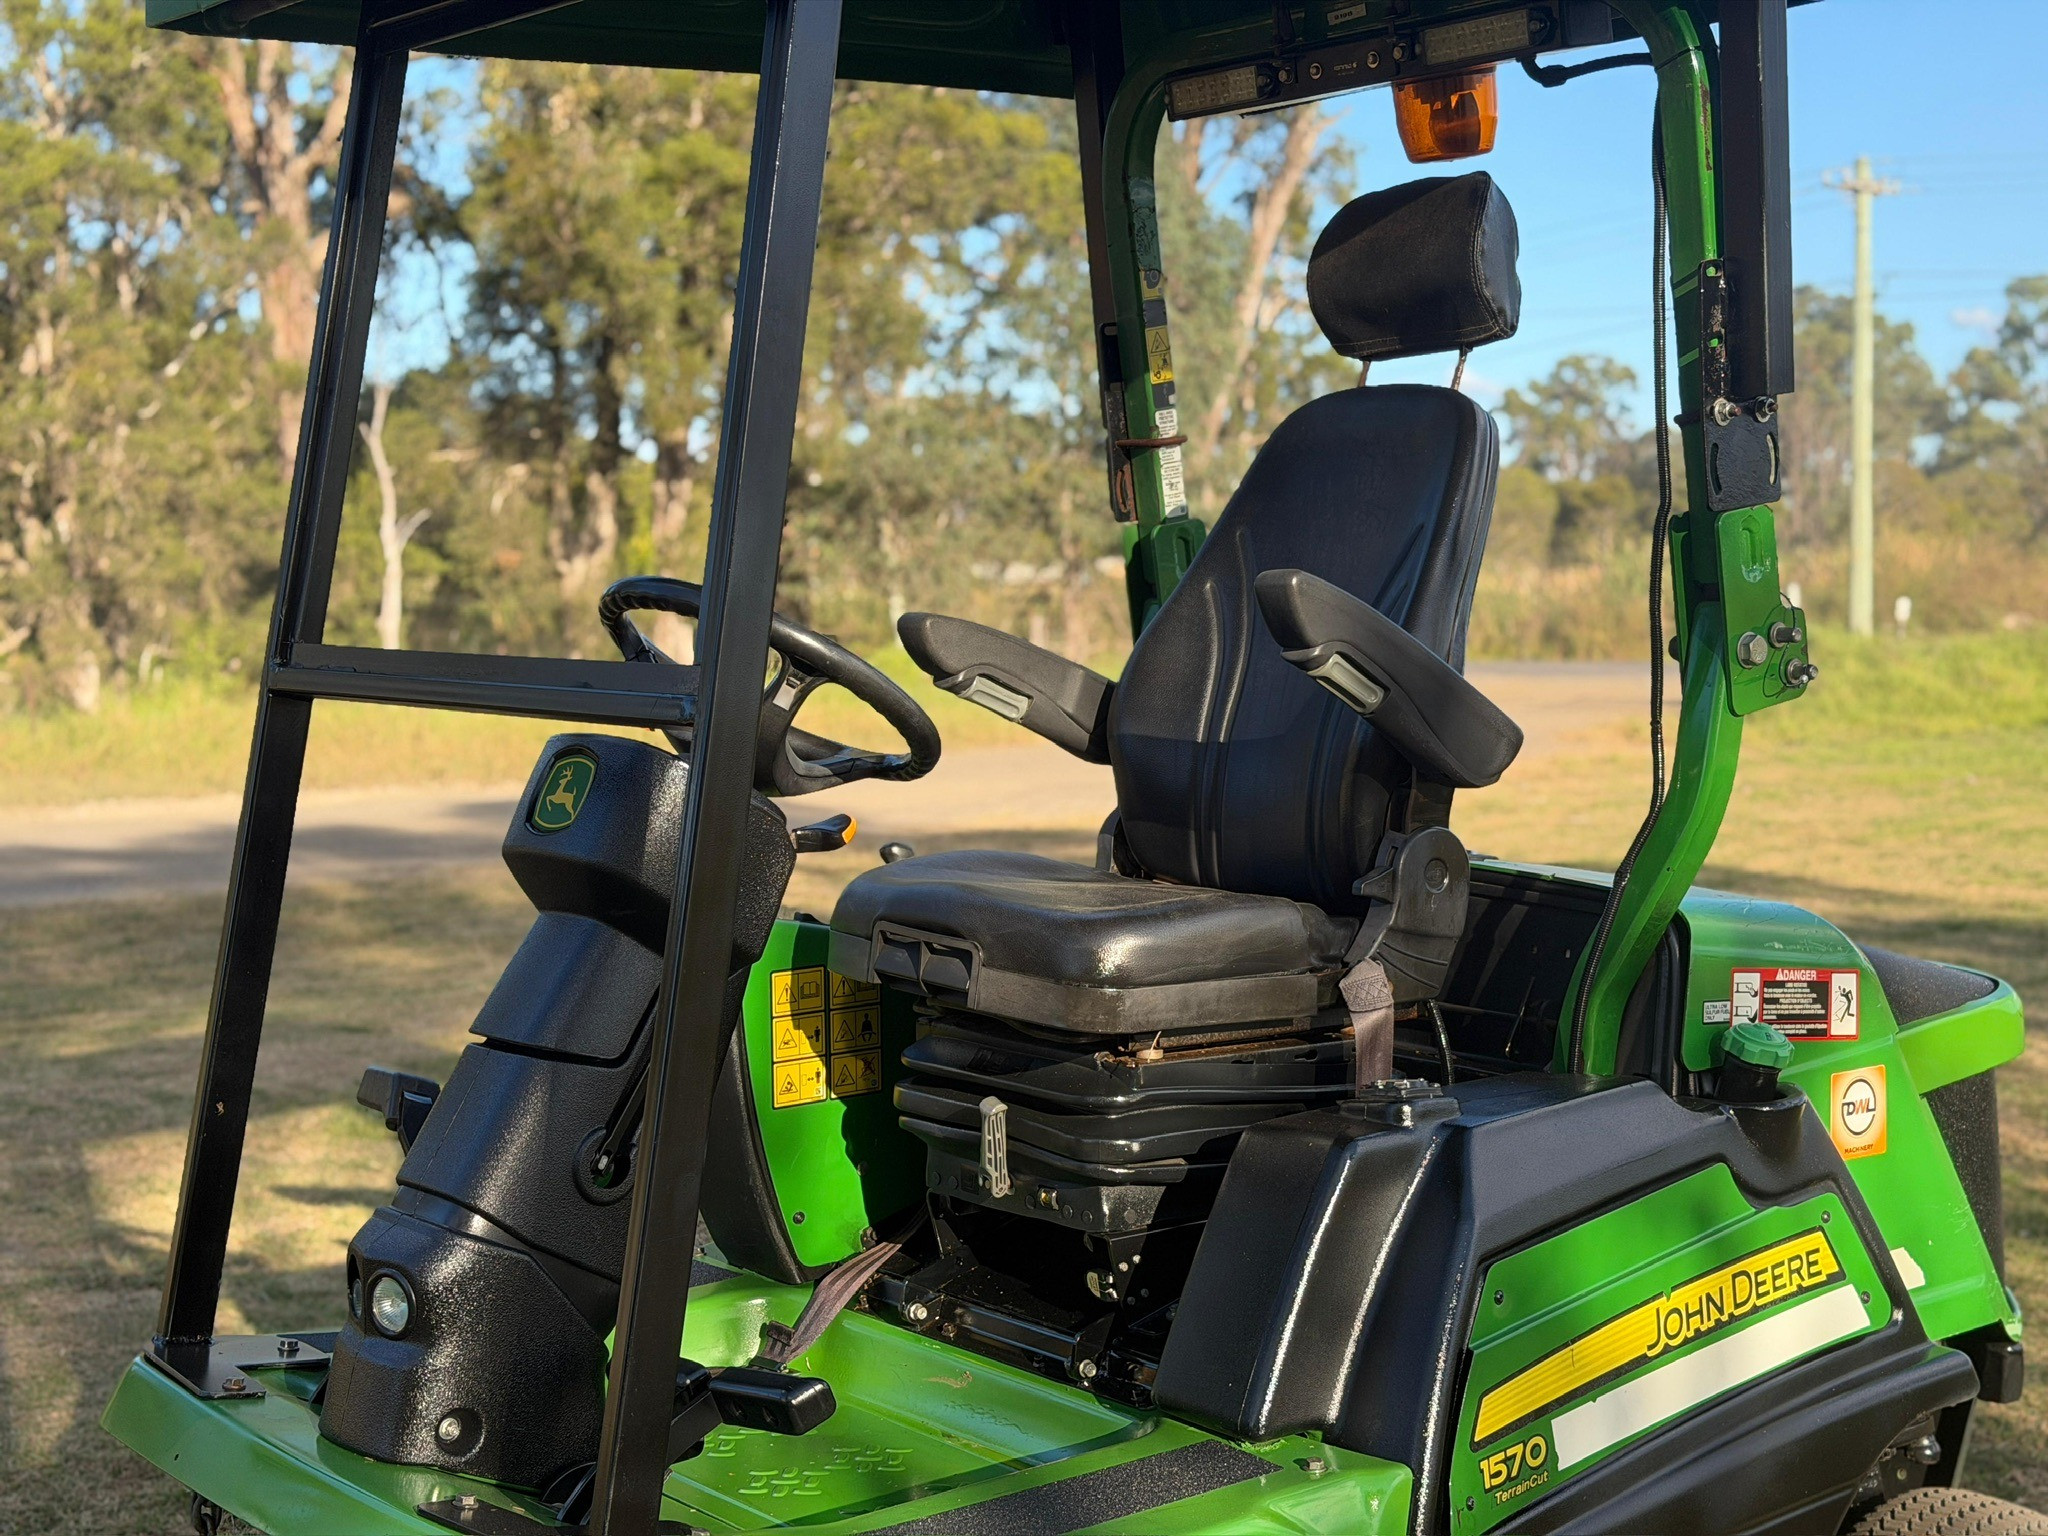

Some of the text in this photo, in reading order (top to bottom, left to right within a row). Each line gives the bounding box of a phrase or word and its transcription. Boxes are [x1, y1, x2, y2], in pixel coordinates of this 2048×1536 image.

[1783, 970, 1817, 981] DANGER
[1843, 1098, 1876, 1116] DWL
[1844, 1143, 1874, 1154] MACHINERY
[1646, 1247, 1823, 1354] JOHN DEERE
[1479, 1435, 1548, 1490] 1570
[1494, 1471, 1549, 1505] TerrainCut
